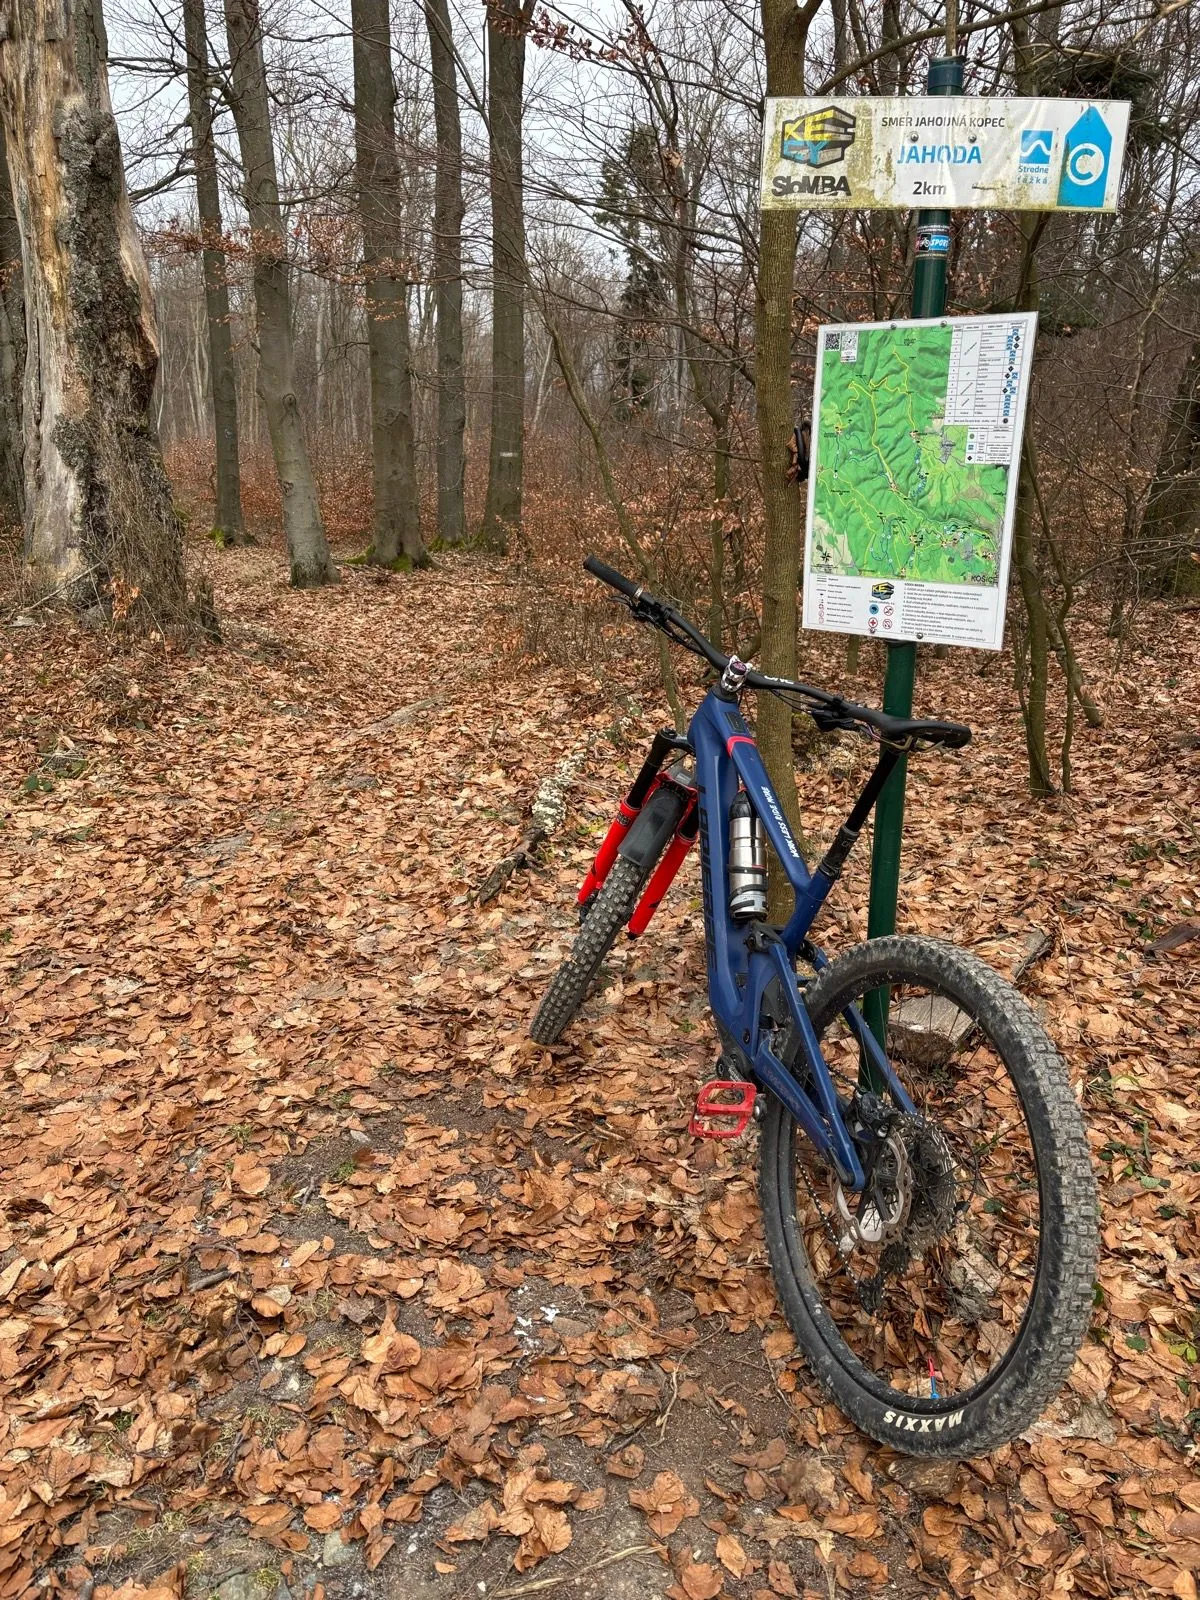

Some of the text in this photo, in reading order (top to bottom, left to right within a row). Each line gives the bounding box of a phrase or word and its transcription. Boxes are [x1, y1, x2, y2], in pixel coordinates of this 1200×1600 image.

[881, 116, 913, 127] SMER
[897, 144, 982, 164] JAHODA
[1018, 165, 1049, 174] Stredne
[912, 181, 947, 195] 2km
[760, 785, 775, 804] MORE
[769, 804, 783, 821] RIDE
[777, 821, 792, 839] LESS
[883, 1409, 965, 1432] MAXXIS
